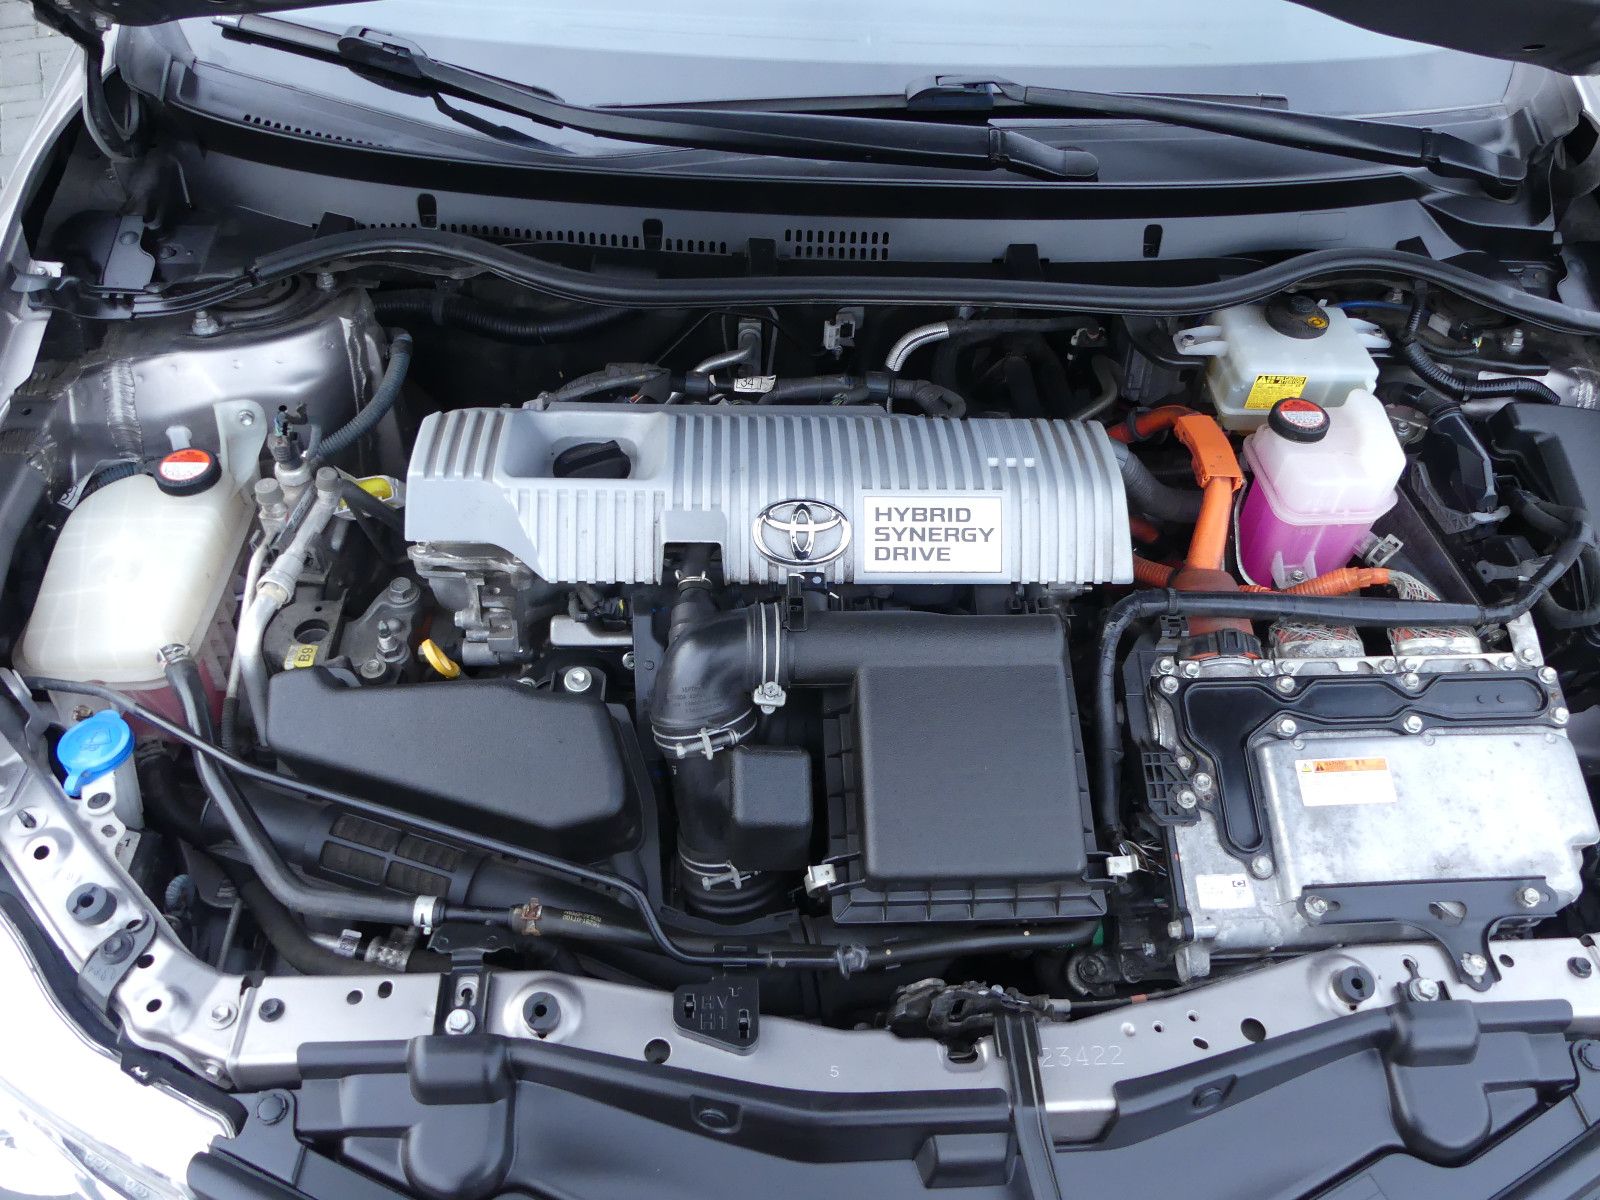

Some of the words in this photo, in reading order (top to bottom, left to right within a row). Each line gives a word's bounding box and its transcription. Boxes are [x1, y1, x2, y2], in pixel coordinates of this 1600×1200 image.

[875, 507, 971, 522] HYBRID
[874, 527, 995, 542] SYNERGY
[874, 547, 951, 561] DRIVE
[1041, 1045, 1125, 1067] 23422
[830, 1065, 839, 1078] 5
